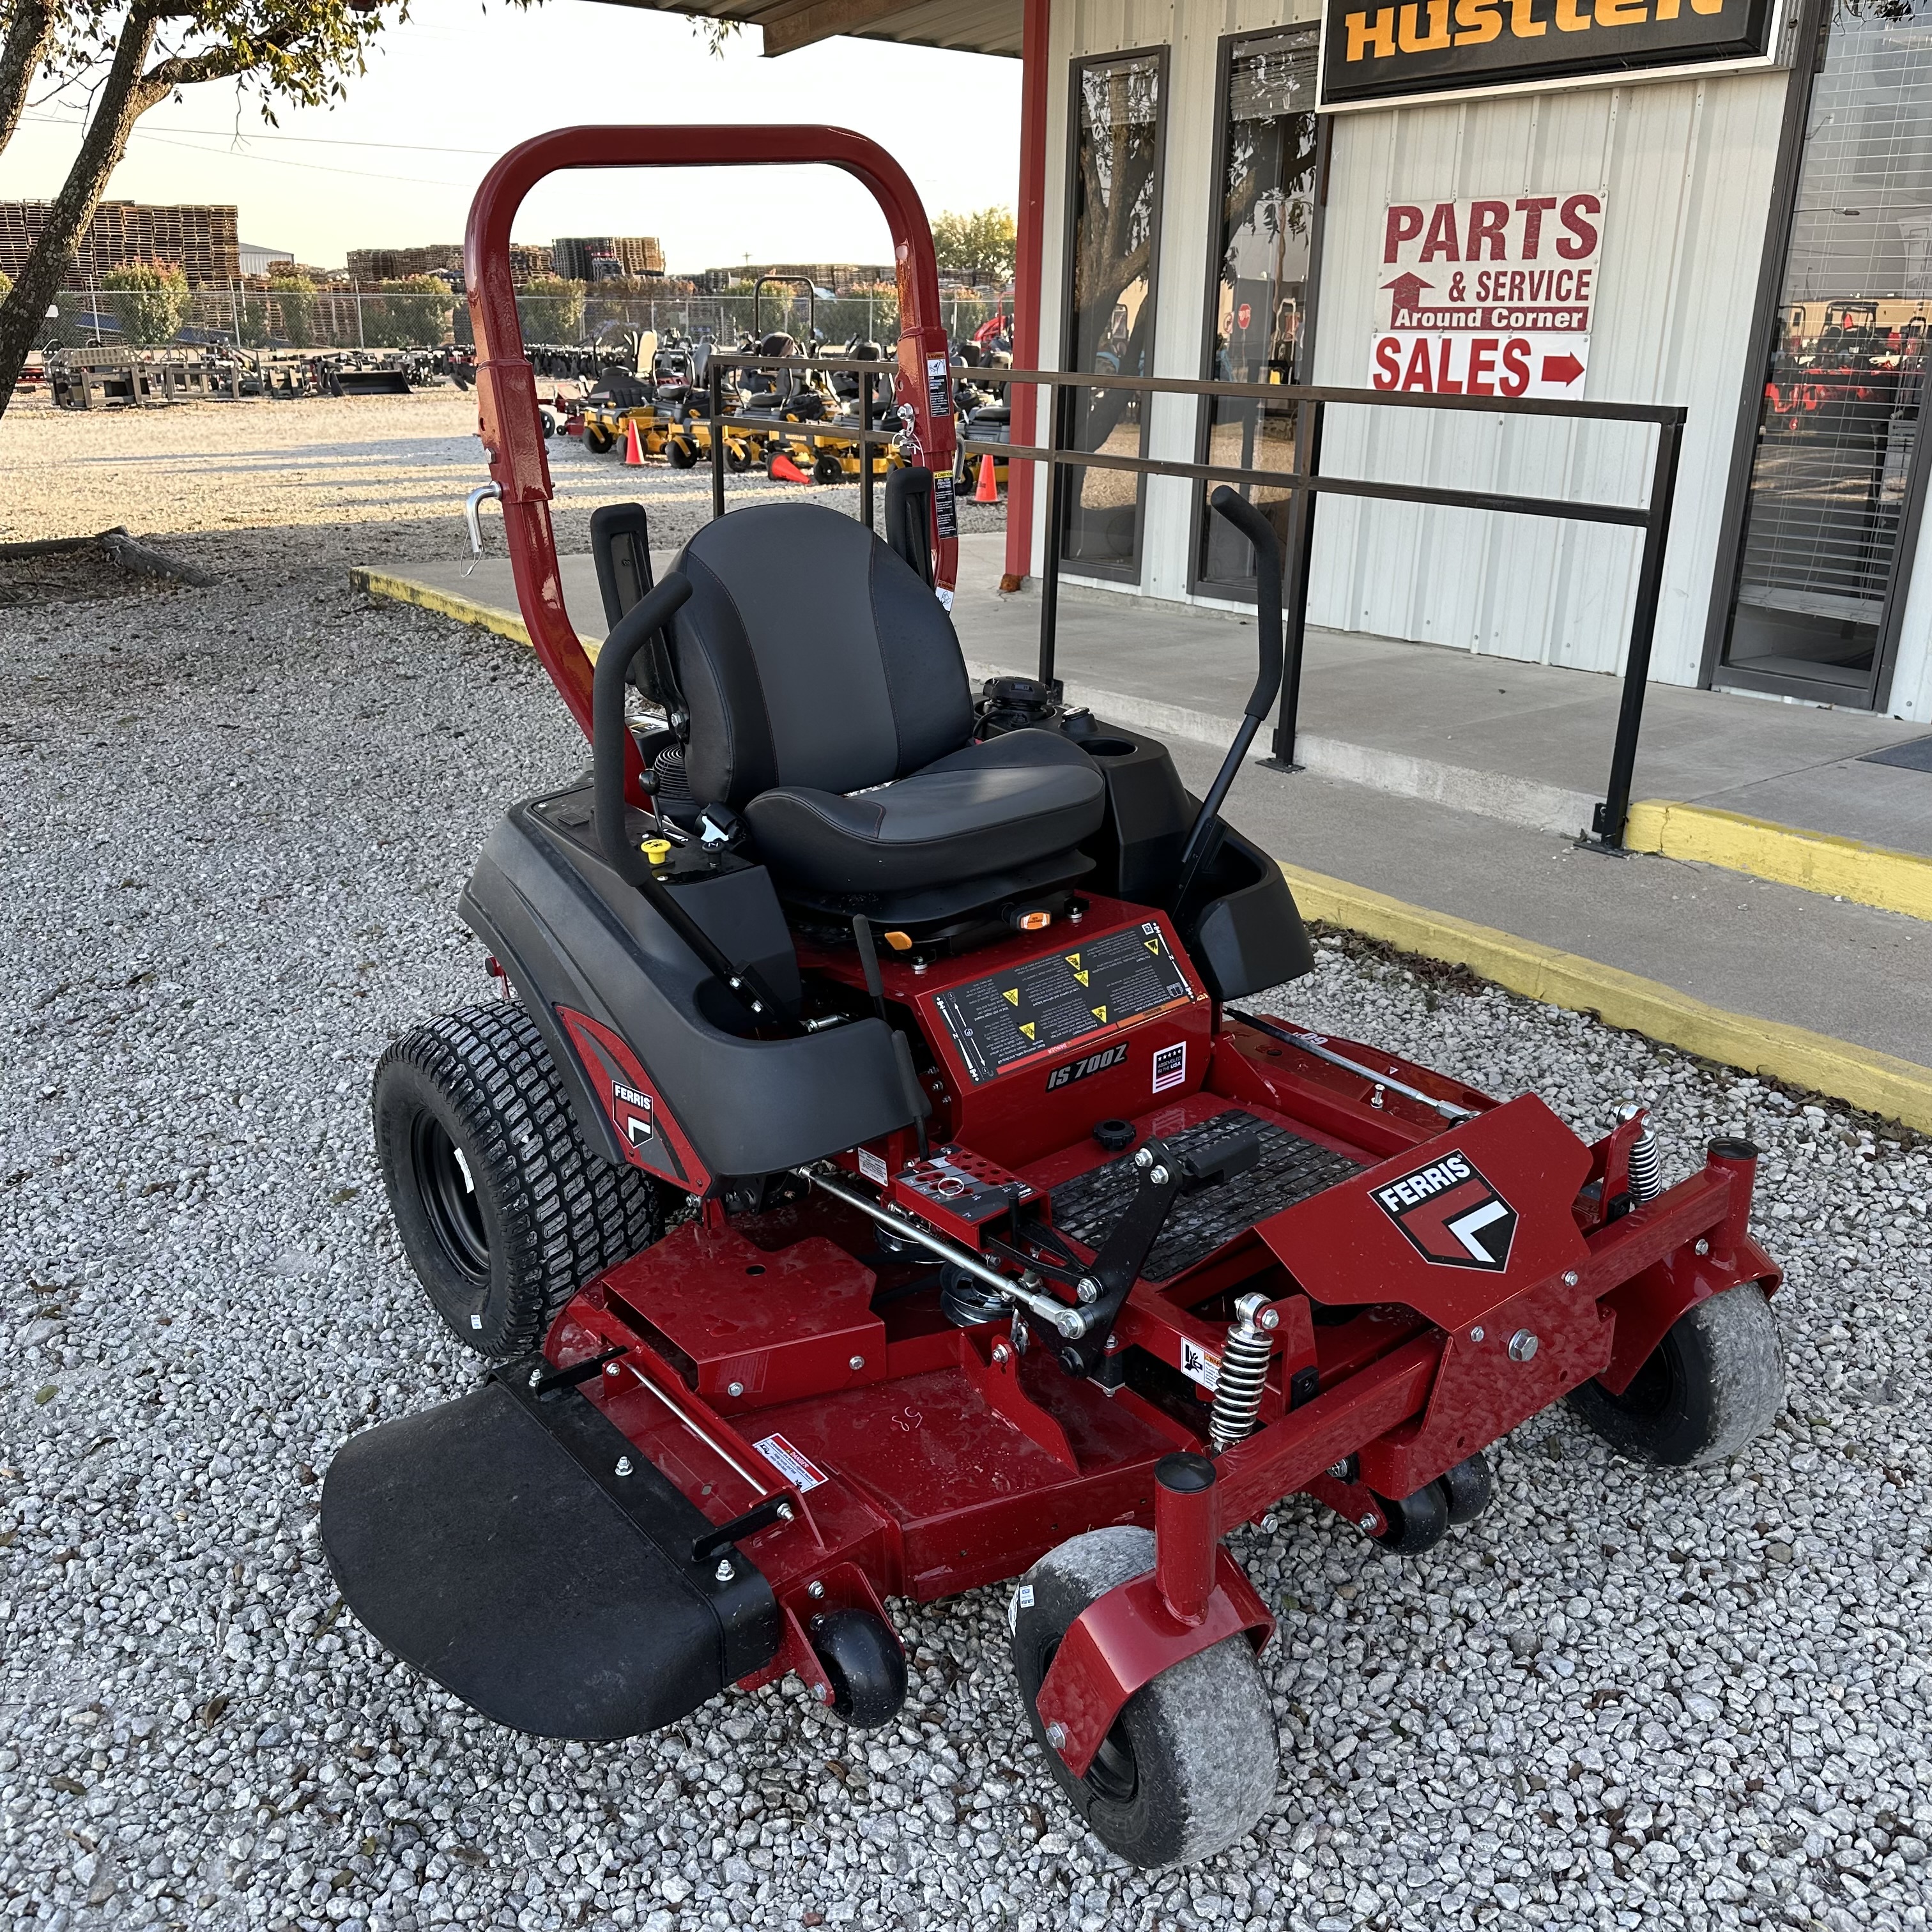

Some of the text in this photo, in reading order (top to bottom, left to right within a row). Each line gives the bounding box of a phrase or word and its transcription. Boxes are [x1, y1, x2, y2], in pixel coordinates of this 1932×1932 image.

[1384, 194, 1600, 263] PARTS
[1448, 269, 1592, 302] & SERVICE
[1394, 307, 1583, 327] Around Corner
[1373, 337, 1531, 397] SALES
[1048, 1044, 1127, 1089] IS 700Z
[615, 1084, 650, 1110] FERRIS
[1378, 1156, 1471, 1213] FERRIS
[790, 1452, 809, 1469] DANGER
